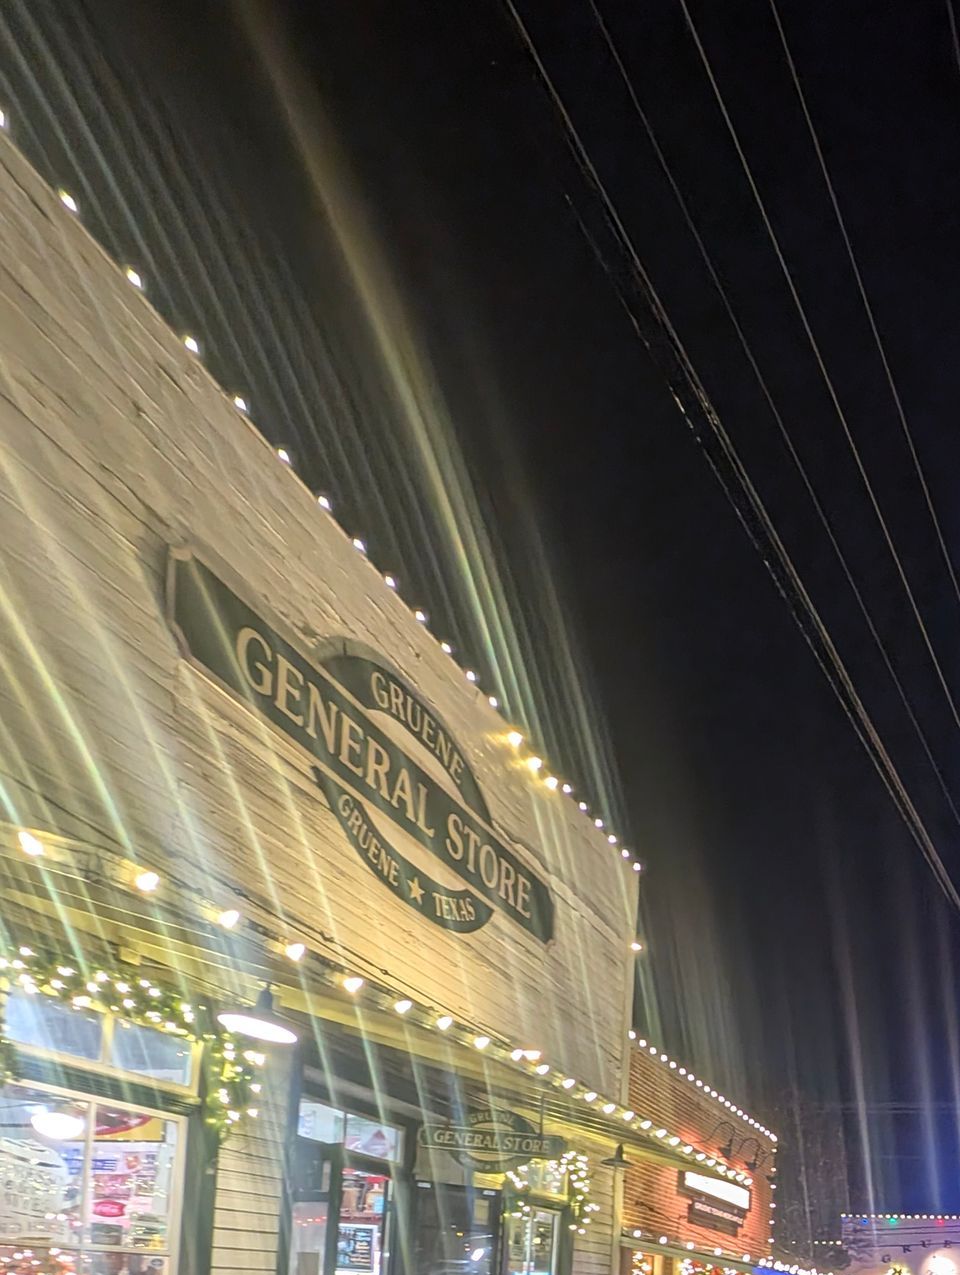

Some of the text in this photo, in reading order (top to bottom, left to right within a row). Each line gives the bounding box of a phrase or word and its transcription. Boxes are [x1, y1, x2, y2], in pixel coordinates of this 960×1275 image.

[235, 627, 531, 919] GENERAL STORE
[370, 671, 465, 784] GRUENE
[338, 794, 475, 922] GRUENE TEXAS
[434, 1129, 549, 1153] GENERAL STORE
